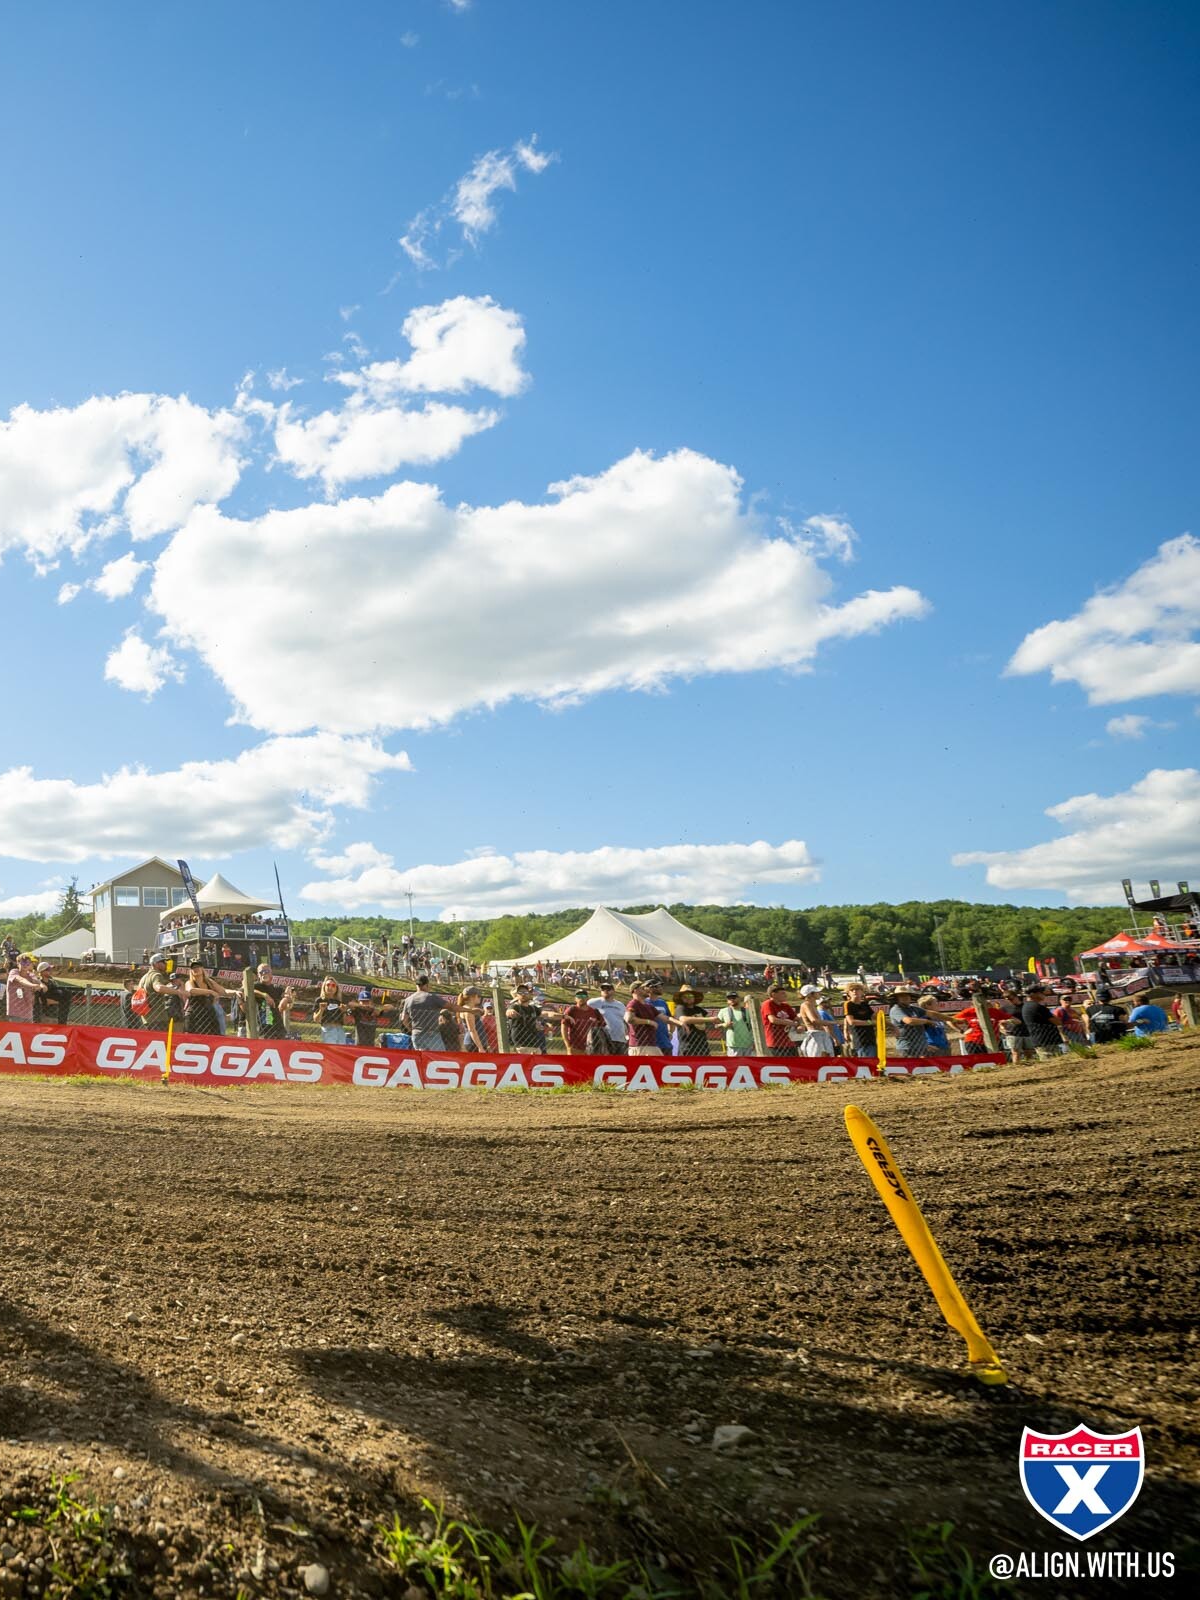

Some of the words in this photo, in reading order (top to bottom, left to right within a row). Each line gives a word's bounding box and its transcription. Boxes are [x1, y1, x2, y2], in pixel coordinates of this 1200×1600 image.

[96, 1037, 323, 1082] GASGAS
[353, 1056, 564, 1090] GASGAS
[592, 1065, 790, 1092] GASGAS
